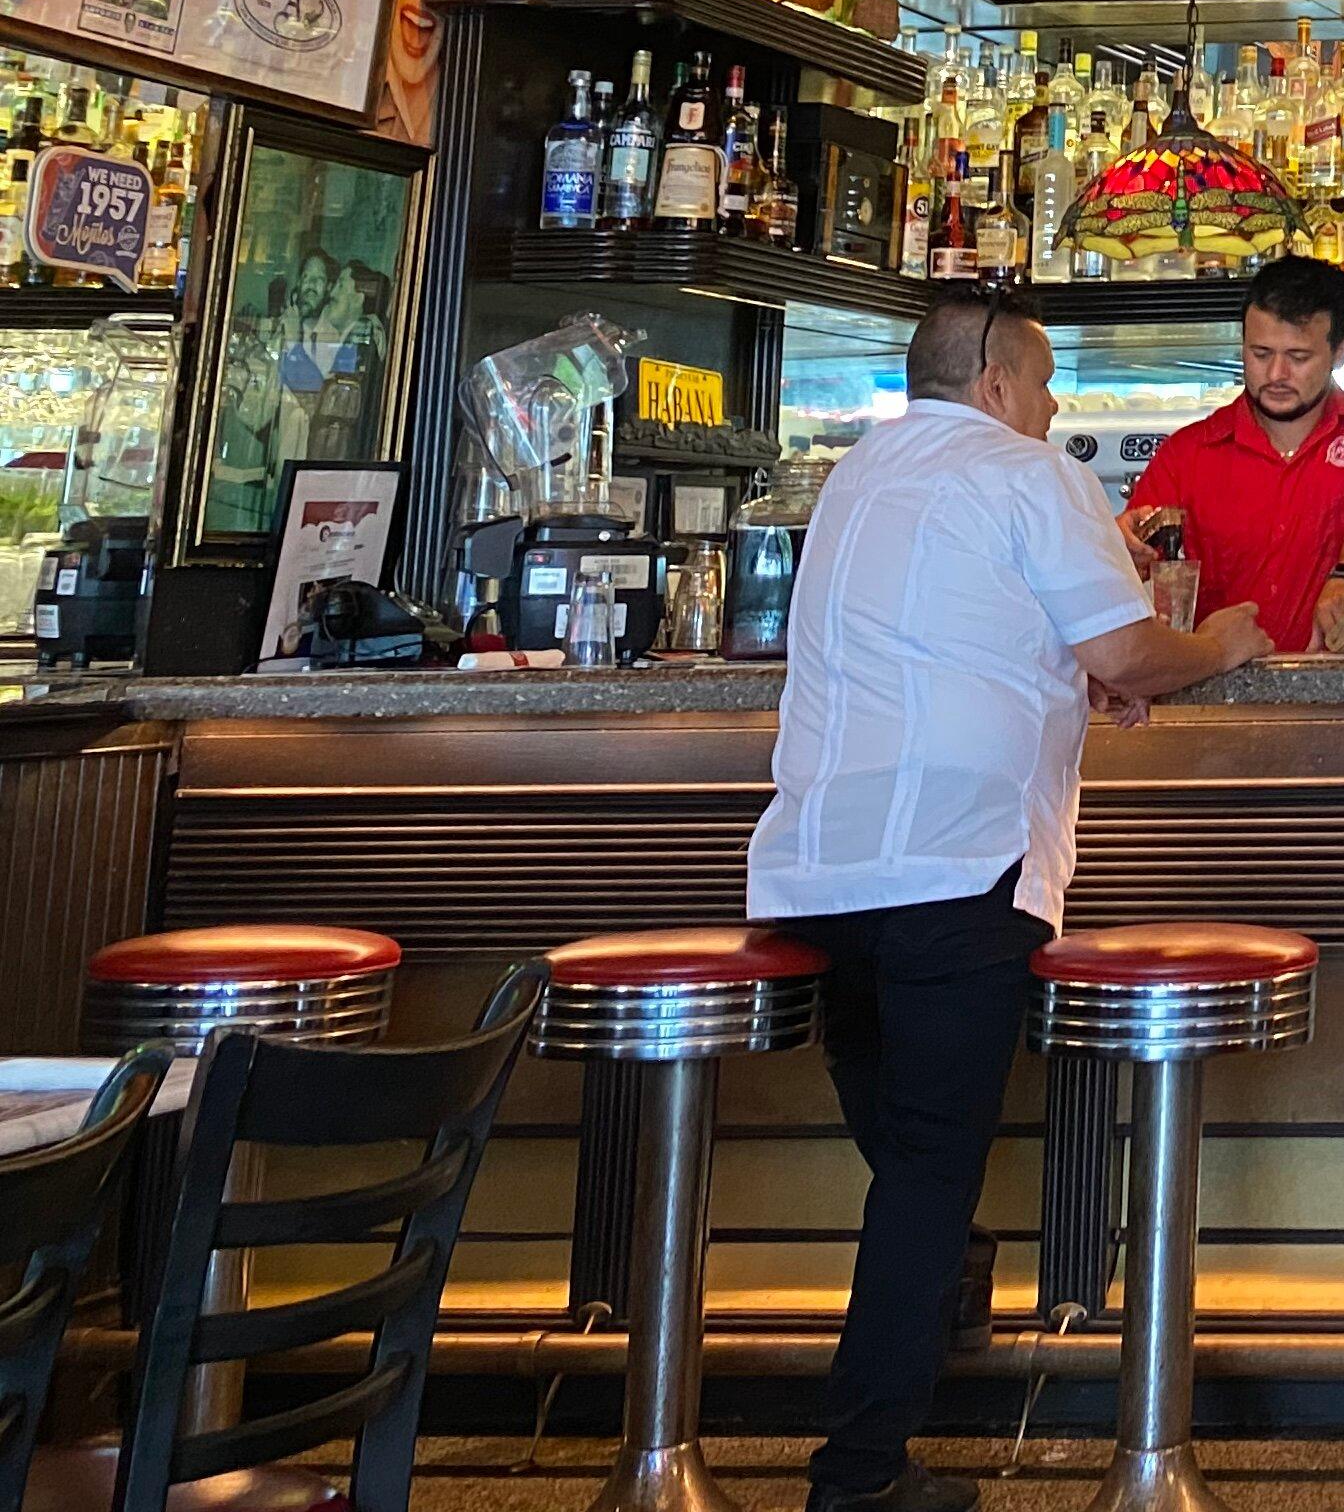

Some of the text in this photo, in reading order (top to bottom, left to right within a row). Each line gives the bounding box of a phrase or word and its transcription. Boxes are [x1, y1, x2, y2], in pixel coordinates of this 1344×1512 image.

[610, 133, 655, 149] CAMPARI
[88, 166, 142, 191] WE NEED
[77, 181, 144, 222] 1957
[56, 213, 115, 255] Mojitos
[647, 381, 716, 426] HABANA
